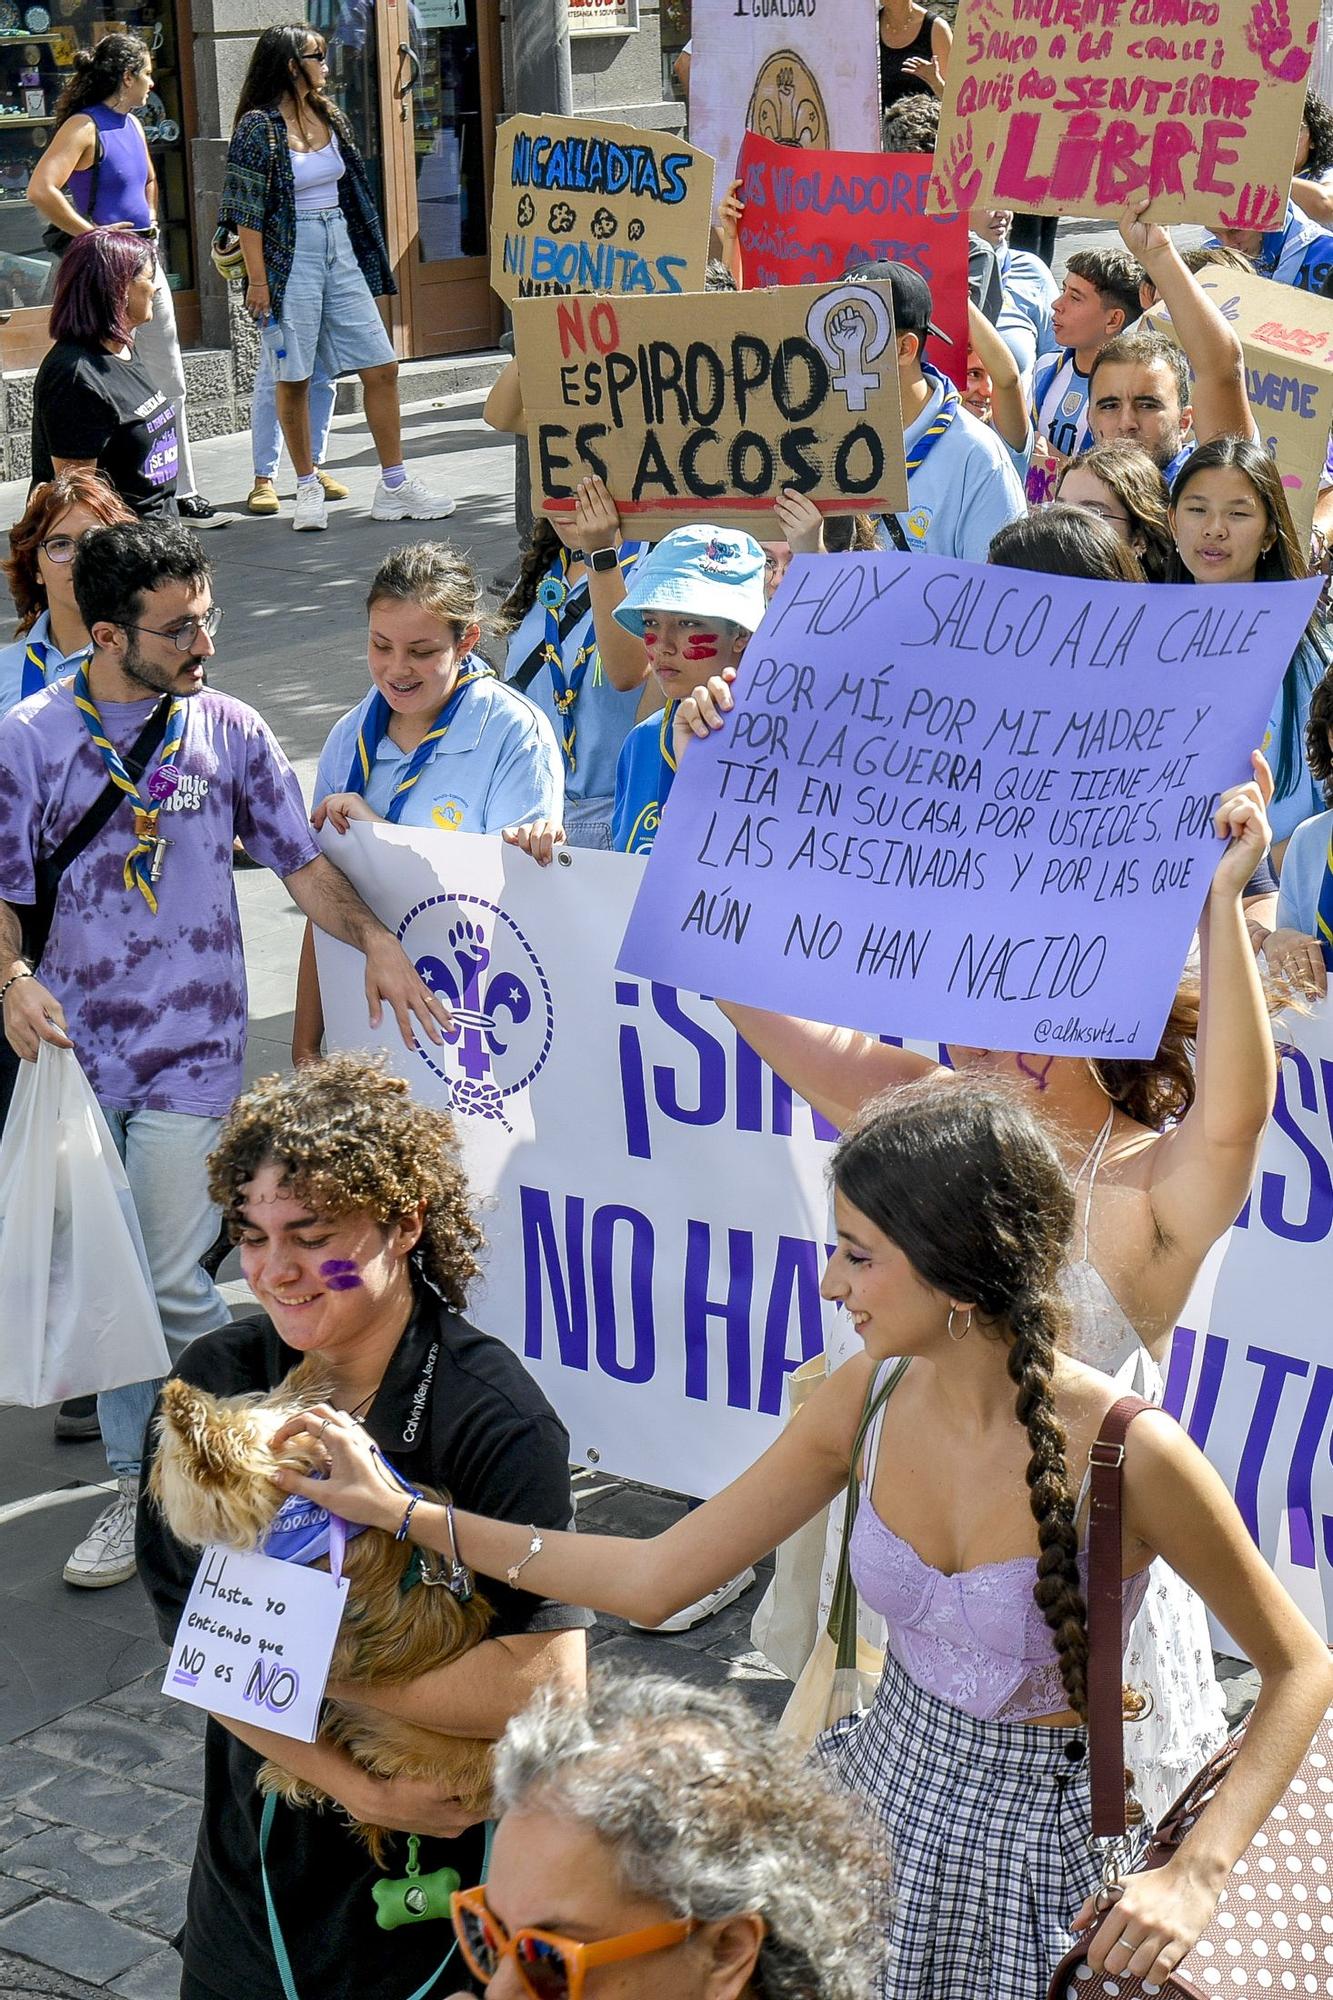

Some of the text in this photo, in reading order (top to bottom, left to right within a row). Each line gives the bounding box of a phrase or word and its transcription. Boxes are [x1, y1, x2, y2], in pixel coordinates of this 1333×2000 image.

[503, 232, 687, 295] NI BONITAS
[556, 298, 620, 358] NO
[560, 331, 830, 428] ES PIROPO
[538, 420, 885, 502] ES ACOSO
[770, 565, 1271, 669] HOY SALGO A LA CALLE
[745, 658, 1212, 759] POR MÍ, POR MI MADRE Y
[717, 755, 779, 806] TÍA
[797, 776, 842, 816] EN
[853, 786, 898, 826] SU
[901, 797, 967, 838] CASA,
[975, 802, 1036, 838] POR
[1174, 793, 1229, 841] POR
[729, 712, 1199, 801] POR LA GUERRA QUE TIENE MI
[697, 811, 1195, 901] LAS ASESINADAS Y POR LAS QUE
[681, 886, 1107, 1001] AÚN NO HAN NACIDO
[519, 1185, 845, 1416] NO HA
[403, 1343, 439, 1443] Calvin Klein Jeans
[200, 1552, 253, 1606] Hasta
[178, 1645, 299, 1712] NO es NO
[188, 1612, 284, 1656] entiendo que
